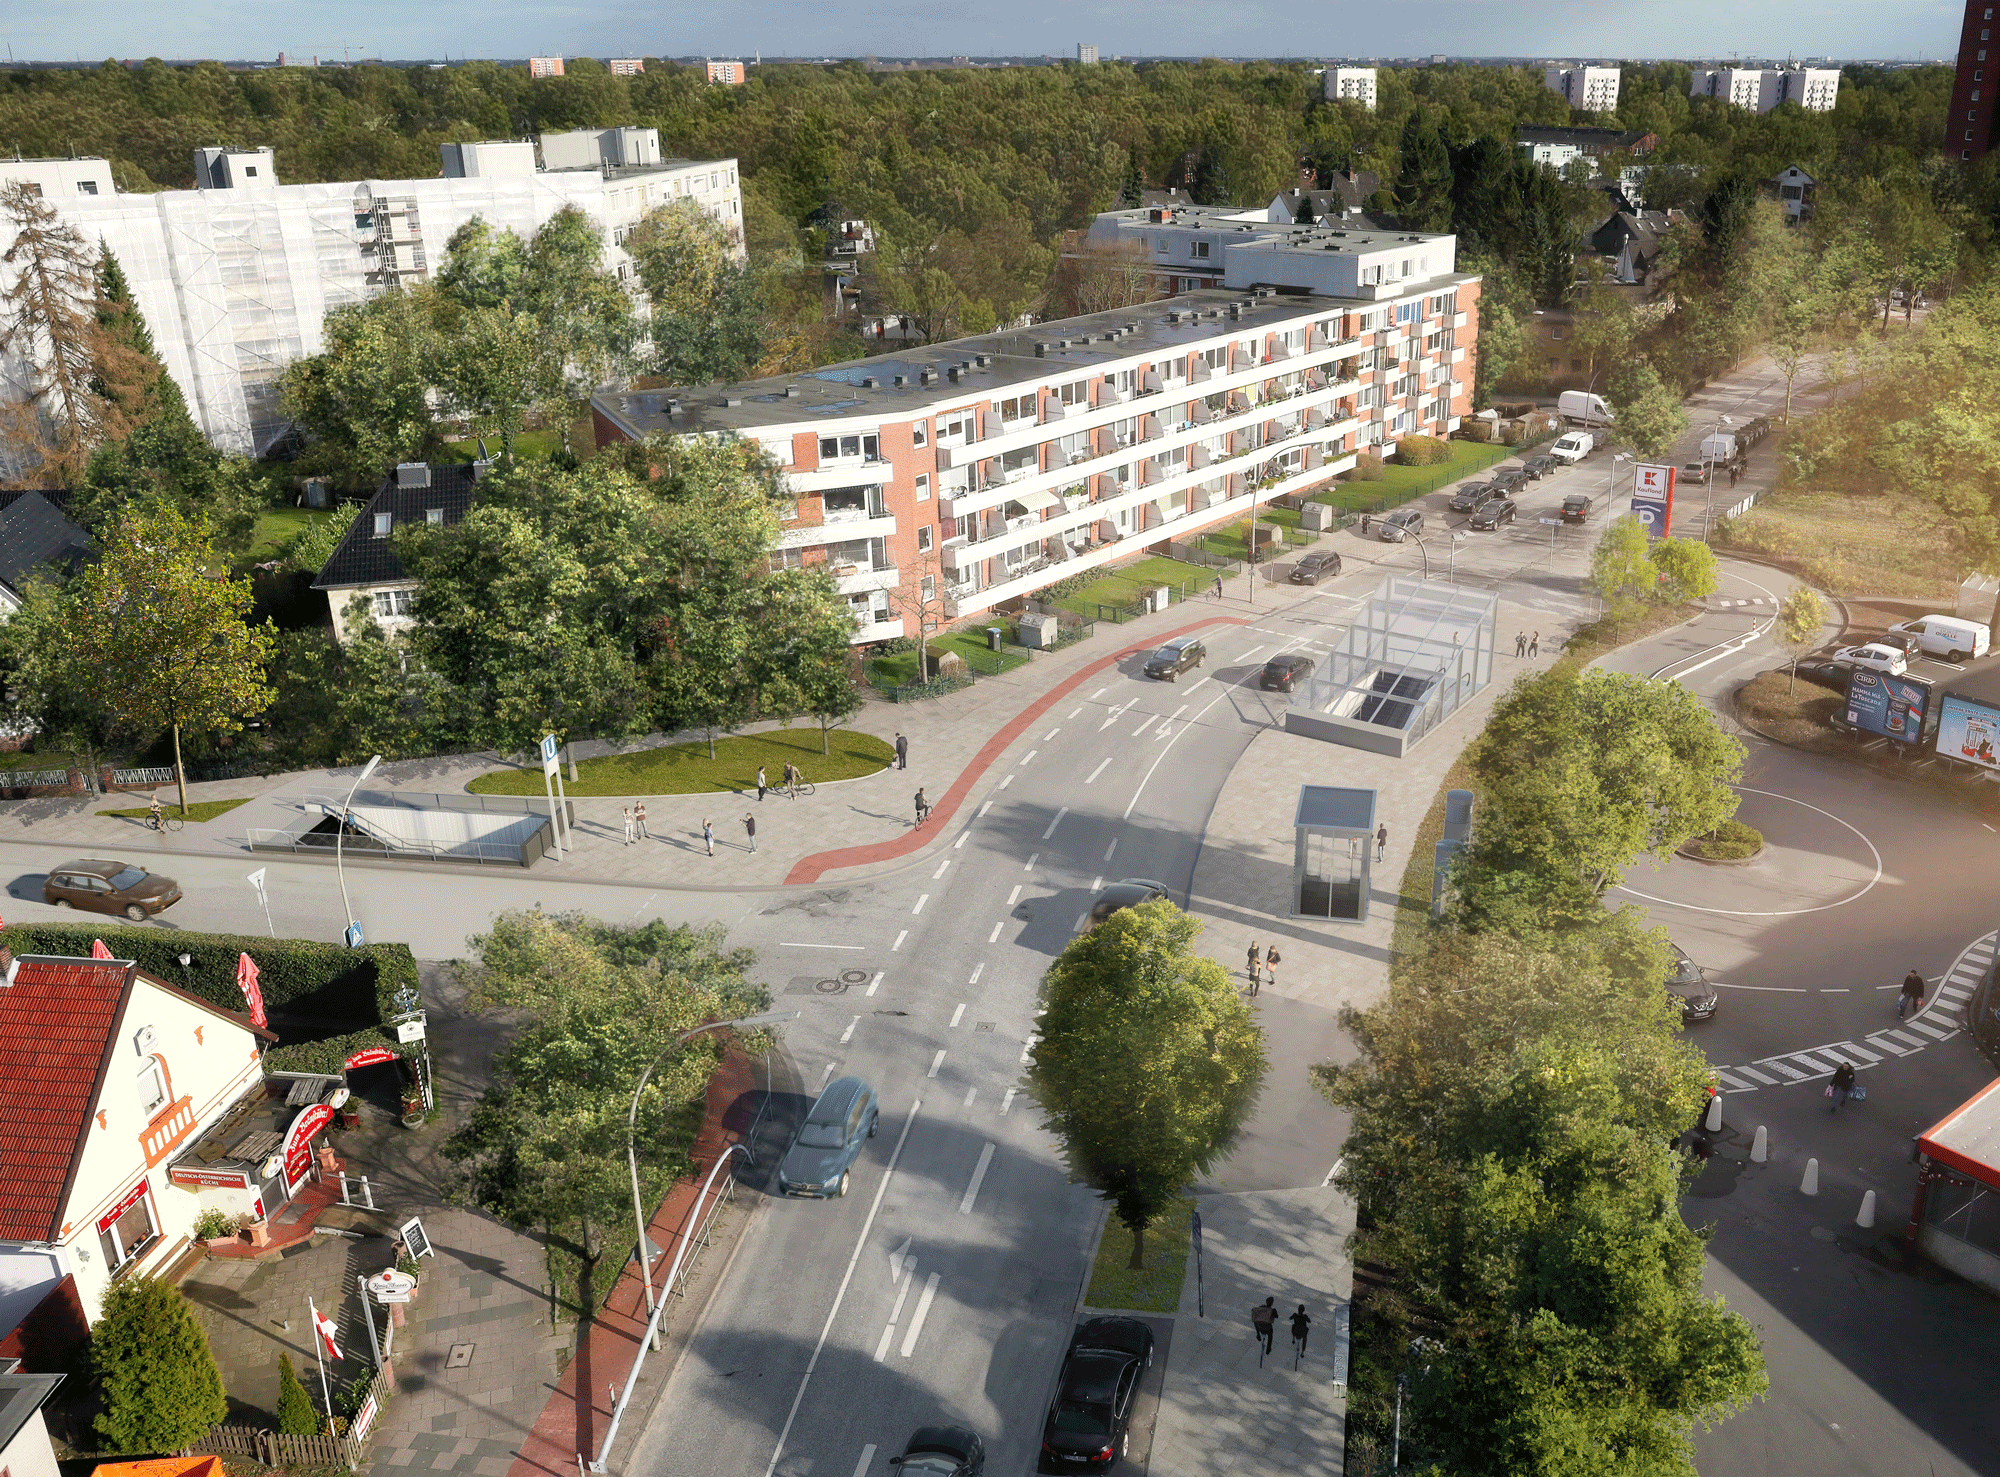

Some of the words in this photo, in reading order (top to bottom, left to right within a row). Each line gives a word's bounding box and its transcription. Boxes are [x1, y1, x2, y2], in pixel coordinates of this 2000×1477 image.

[1637, 486, 1662, 495] Kaufland
[1856, 674, 1876, 685] CIRIO
[545, 736, 556, 759] U
